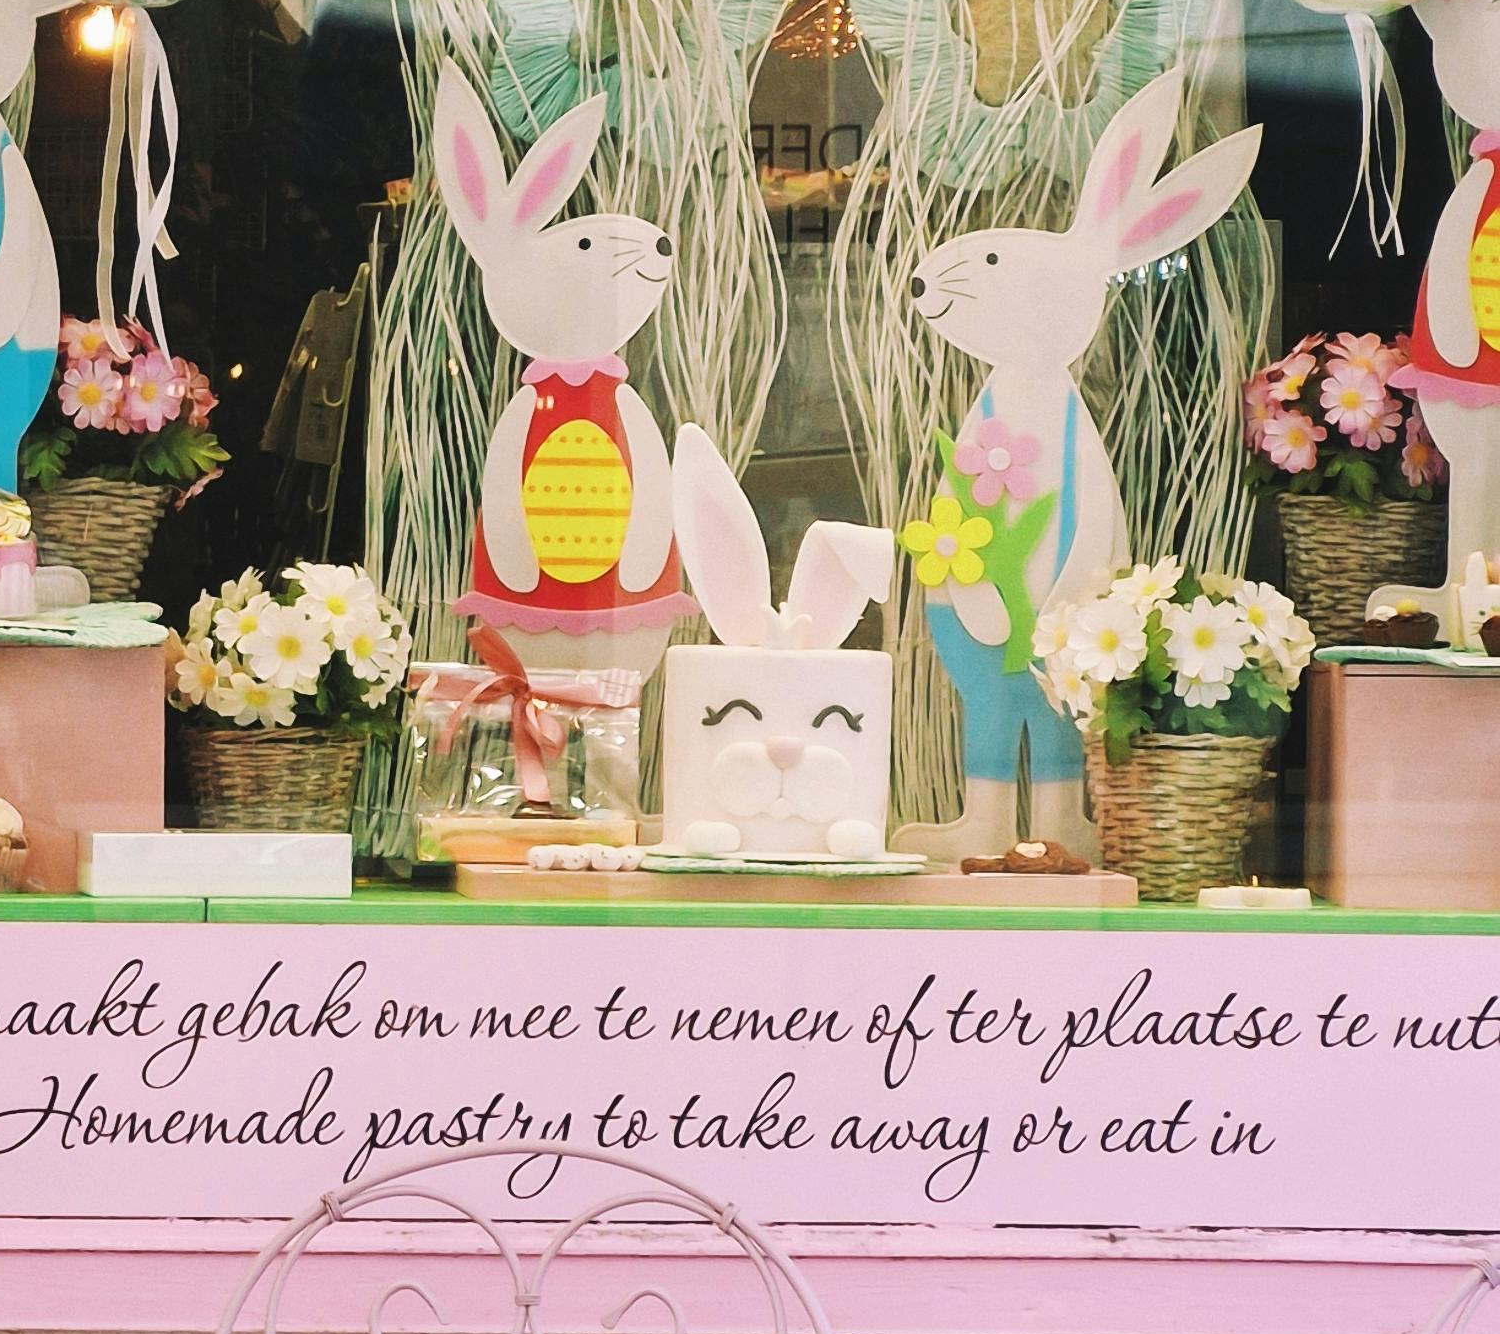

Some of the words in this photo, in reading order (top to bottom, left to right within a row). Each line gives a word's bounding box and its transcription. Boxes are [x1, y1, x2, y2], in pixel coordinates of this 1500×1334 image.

[142, 959, 366, 1089] gebak
[374, 999, 459, 1040] om
[469, 1004, 580, 1040] mee
[594, 986, 655, 1041] te
[670, 1006, 852, 1043] nemen
[866, 973, 936, 1090] of
[946, 989, 1045, 1046] ter
[1040, 968, 1301, 1084] plaatse
[1317, 993, 1378, 1048] te
[1393, 995, 1500, 1052] nut
[342, 1092, 574, 1201] pastry
[593, 1093, 658, 1149] to
[669, 1071, 815, 1150] take
[830, 1115, 990, 1203] away
[1012, 1107, 1087, 1154] or
[1100, 1099, 1197, 1154] eat
[1210, 1109, 1276, 1156] in
